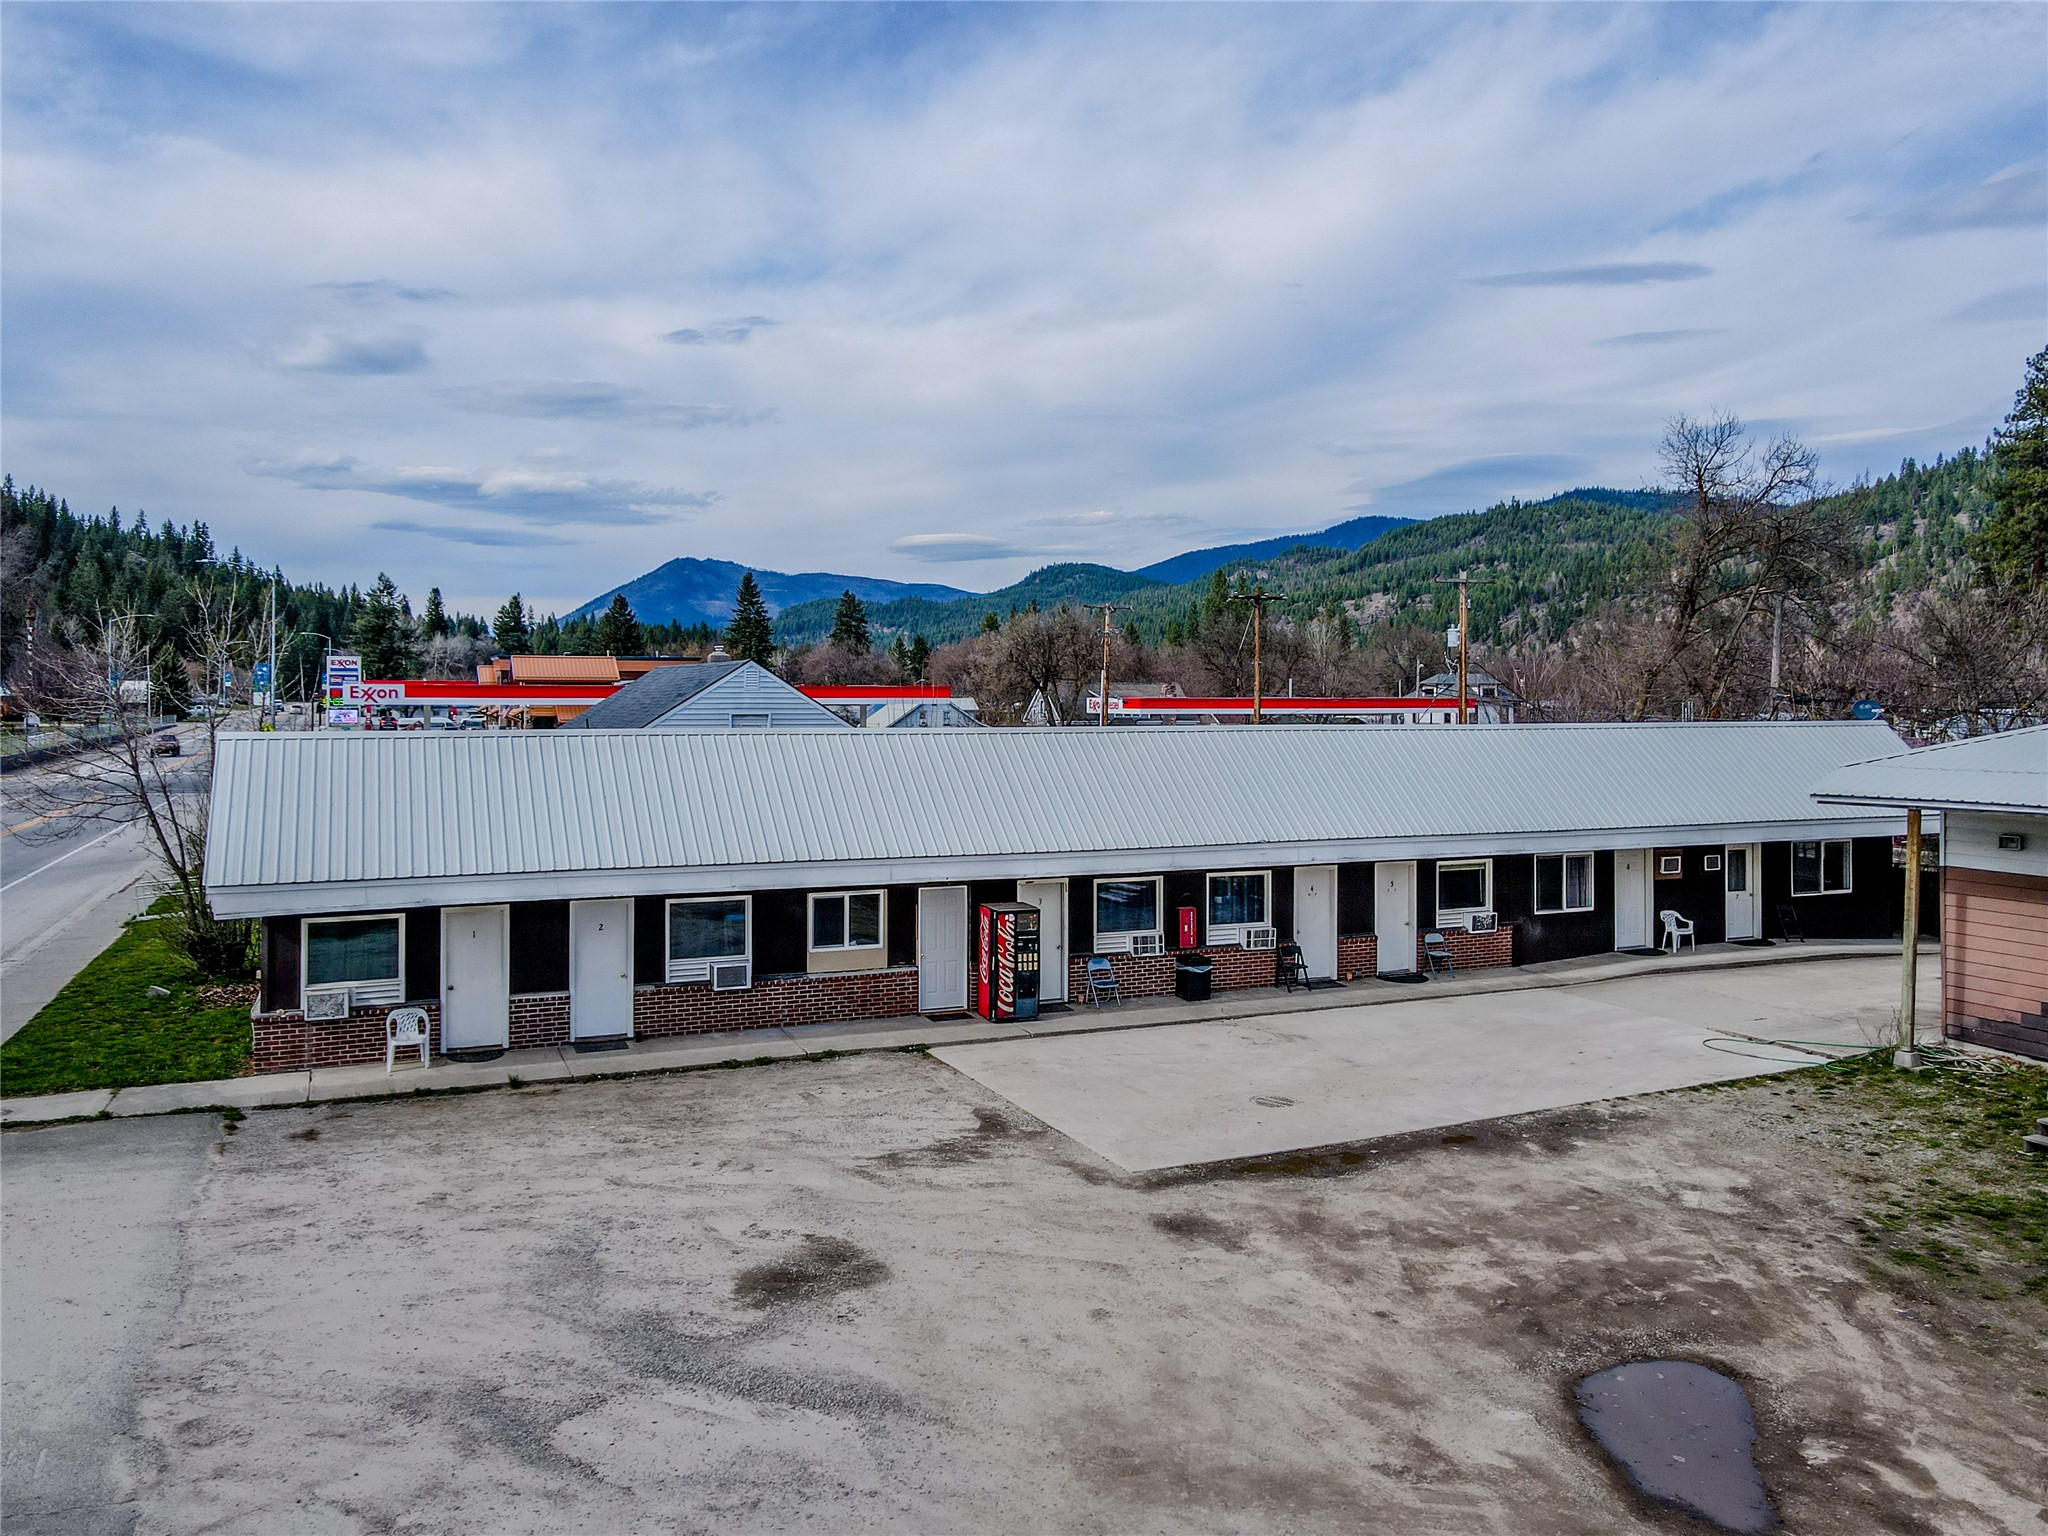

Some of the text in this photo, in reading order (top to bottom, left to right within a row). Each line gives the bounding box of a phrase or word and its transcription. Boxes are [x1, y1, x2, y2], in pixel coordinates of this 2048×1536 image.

[330, 659, 358, 669] EXXON
[349, 685, 399, 703] Exxon
[598, 923, 604, 931] 2
